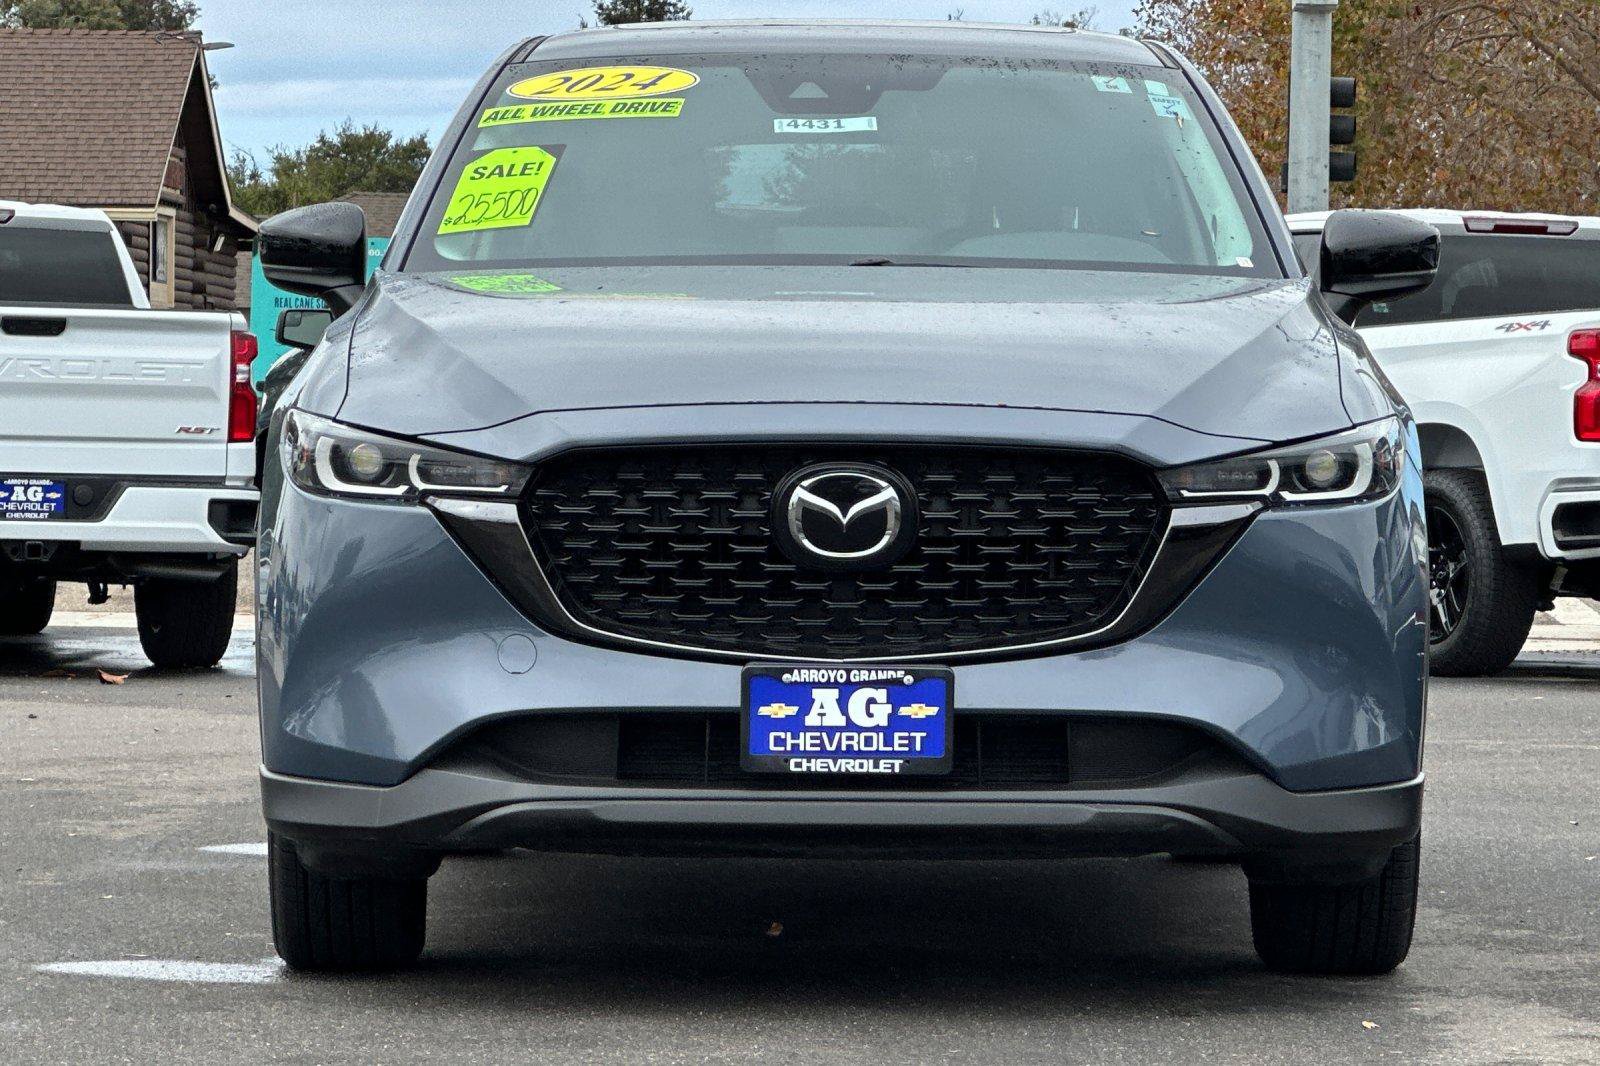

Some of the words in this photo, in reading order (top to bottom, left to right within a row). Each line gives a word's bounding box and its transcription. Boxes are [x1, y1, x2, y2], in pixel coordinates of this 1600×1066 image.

[530, 72, 674, 95] 2024
[483, 107, 523, 123] ALL
[530, 102, 604, 118] WHEEL
[609, 101, 678, 114] DRIVE
[786, 119, 845, 129] 4431
[469, 161, 544, 180] SALE!
[274, 297, 292, 308] REAL
[294, 297, 314, 308] CANE
[175, 426, 220, 434] RST
[10, 486, 44, 501] AG
[791, 669, 847, 683] ARROYO
[804, 687, 893, 728] AG
[769, 731, 927, 751] CHEVROLET
[789, 758, 904, 773] CHEVROLET
